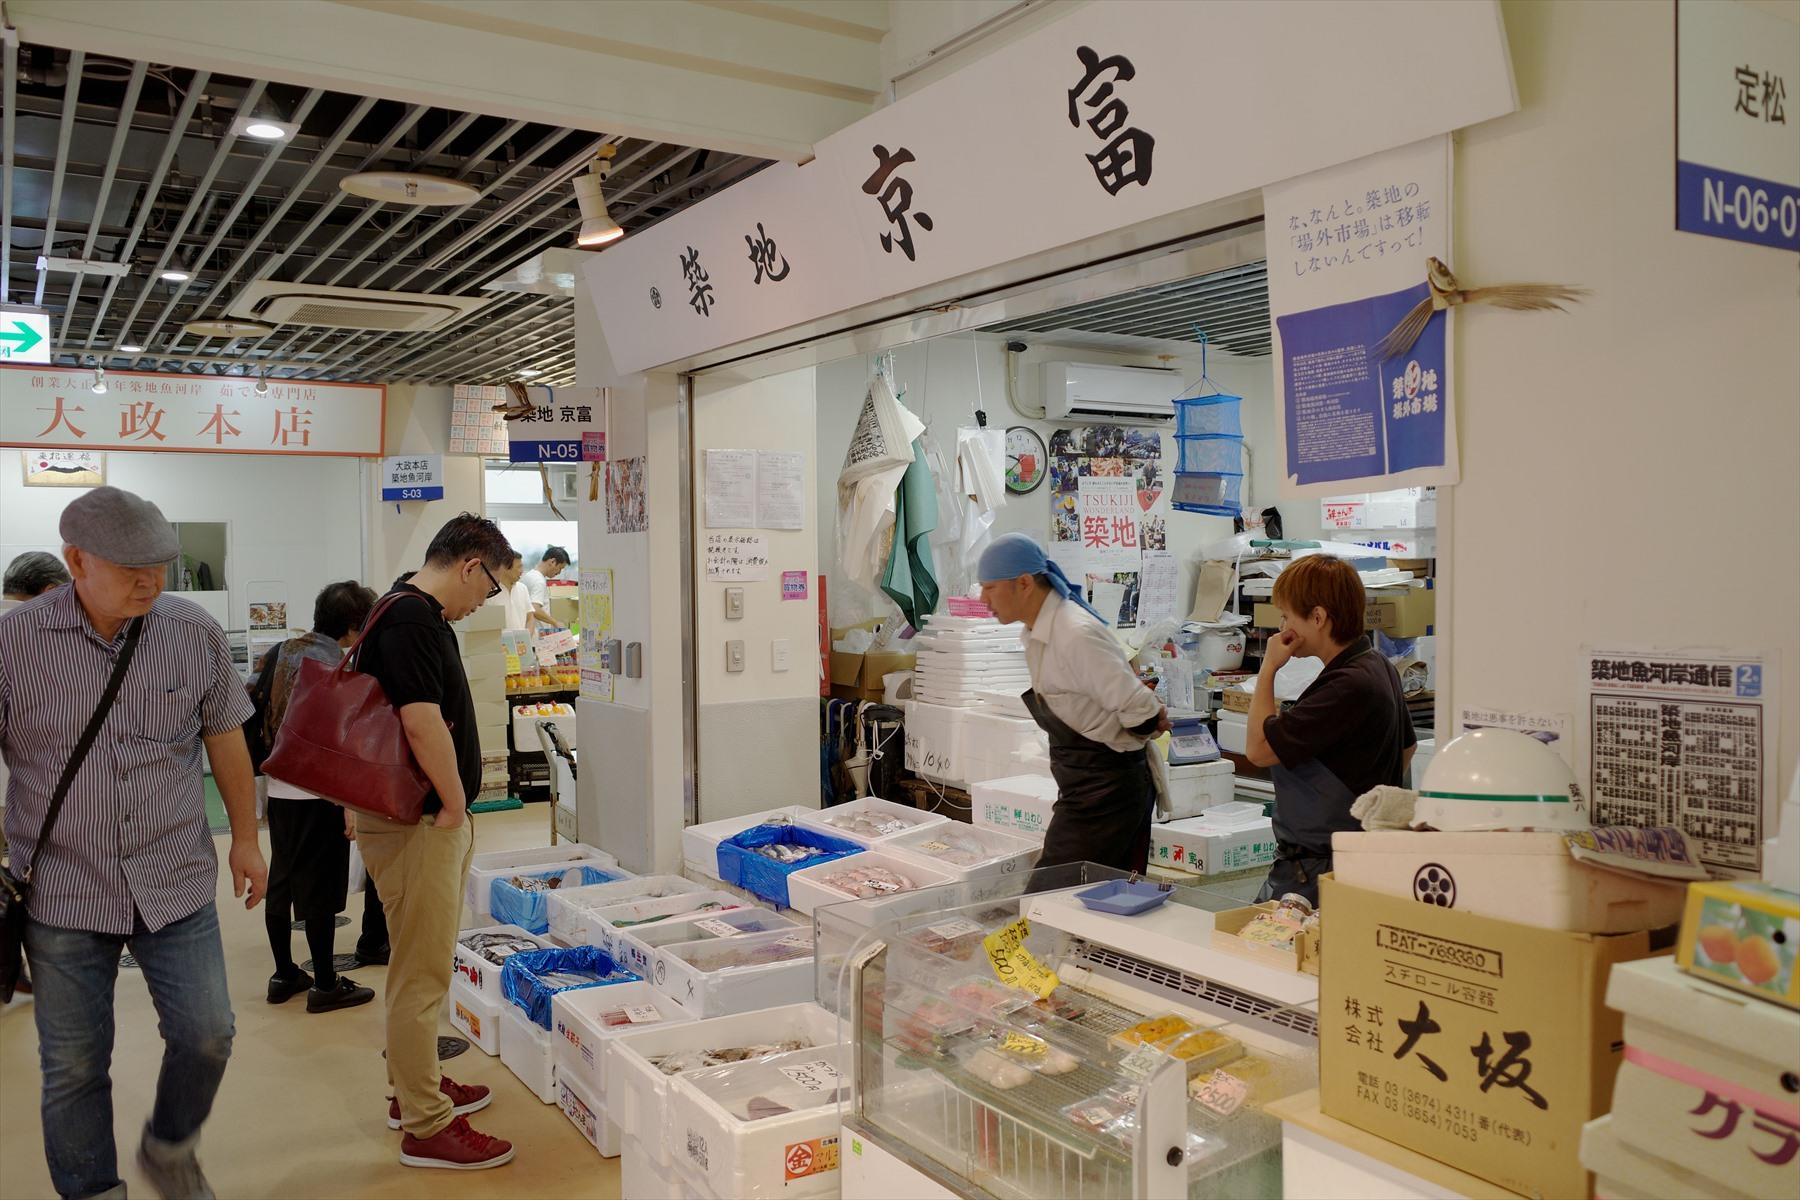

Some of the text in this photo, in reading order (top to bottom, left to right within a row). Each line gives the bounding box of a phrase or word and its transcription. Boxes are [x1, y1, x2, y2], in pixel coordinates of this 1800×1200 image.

[1735, 64, 1786, 125] 定松
[32, 376, 202, 396] 創業大正年築地魚河岸
[35, 396, 314, 447] 大政本店
[560, 405, 592, 423] 京富
[538, 443, 578, 459] N-05
[391, 472, 433, 484] 築地魚河岸
[395, 459, 428, 471] 大政本店
[402, 488, 422, 499] S-03
[1083, 494, 1134, 506] TSUKIJI
[1084, 515, 1137, 549] 築地
[1591, 659, 1733, 688] 築地魚河岸通信
[1660, 703, 1682, 768] 築地魚河岸
[1385, 965, 1496, 1007] スチロール容器
[1344, 995, 1384, 1027] 株式
[1344, 1024, 1384, 1054] 会社
[1393, 1000, 1549, 1111] 大坂
[1357, 1070, 1380, 1089] 電話
[1356, 1085, 1380, 1105] FAX
[788, 1145, 813, 1171] 金
